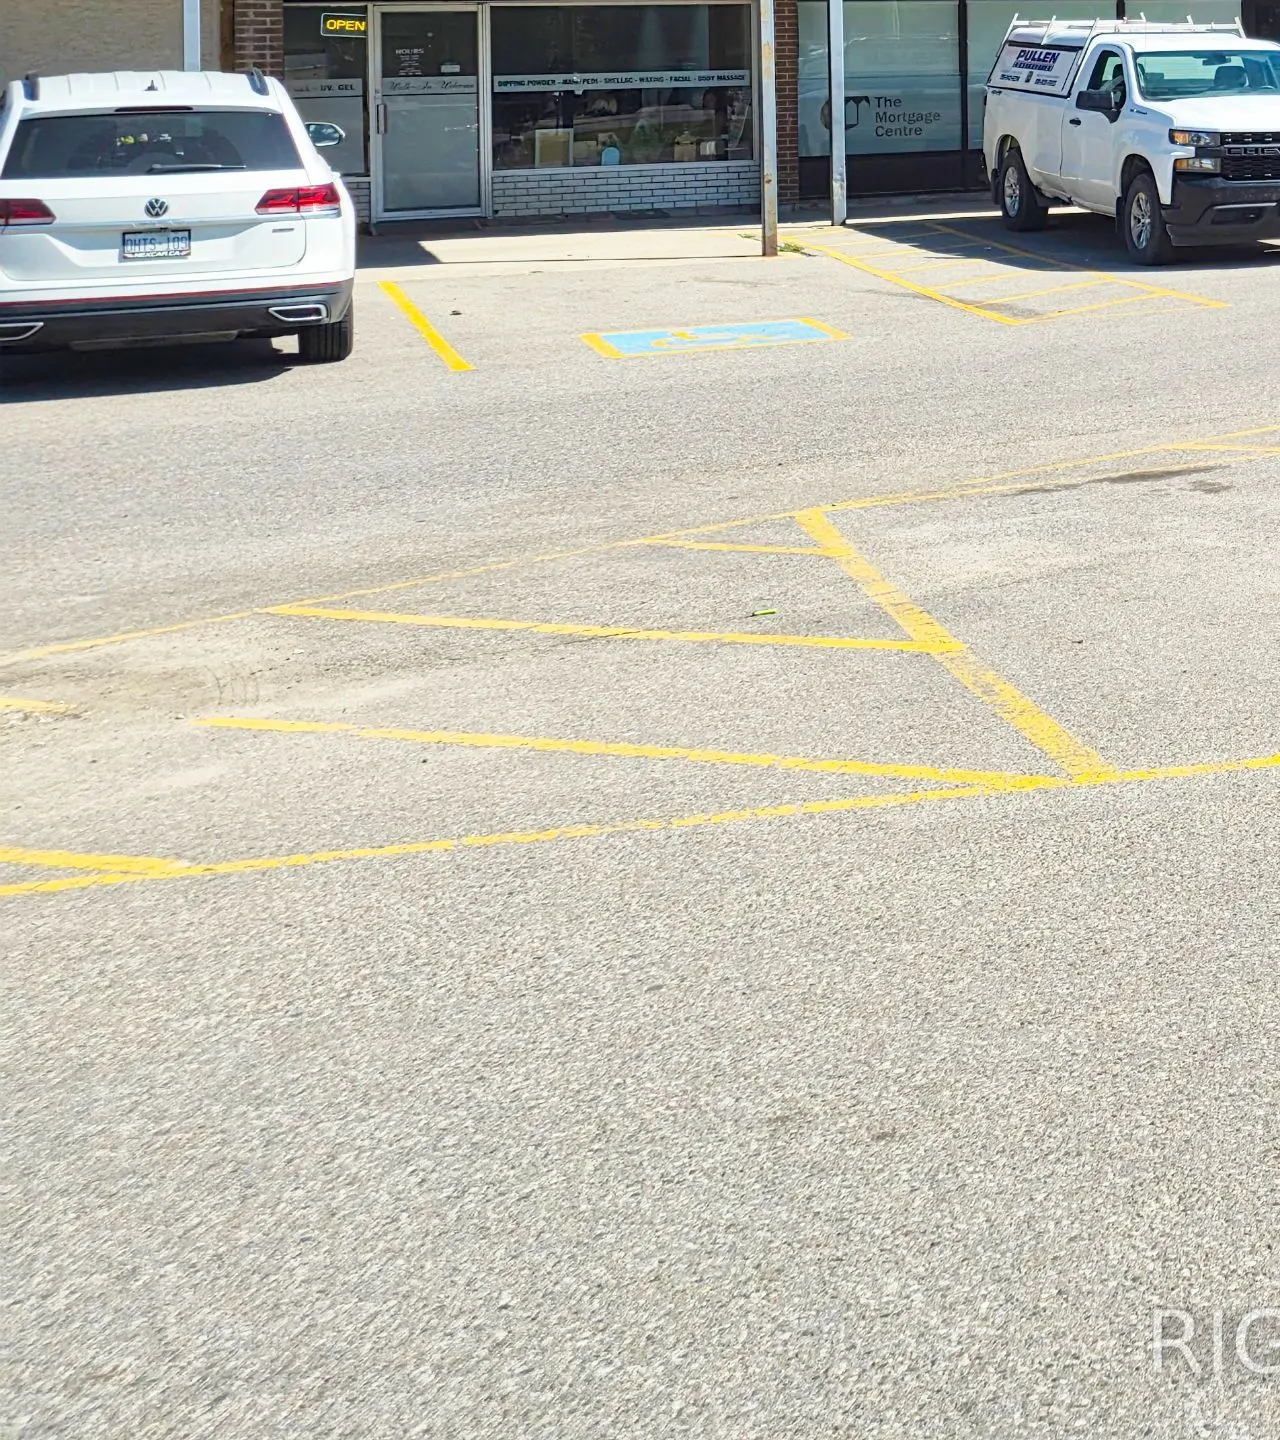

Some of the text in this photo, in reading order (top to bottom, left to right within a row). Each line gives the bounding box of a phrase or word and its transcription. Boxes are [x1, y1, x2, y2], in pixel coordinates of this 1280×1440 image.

[326, 19, 366, 32] OPEN
[1015, 48, 1061, 65] PULLEN
[874, 96, 902, 109] The
[875, 111, 941, 125] Mortgage
[875, 125, 923, 137] Centre
